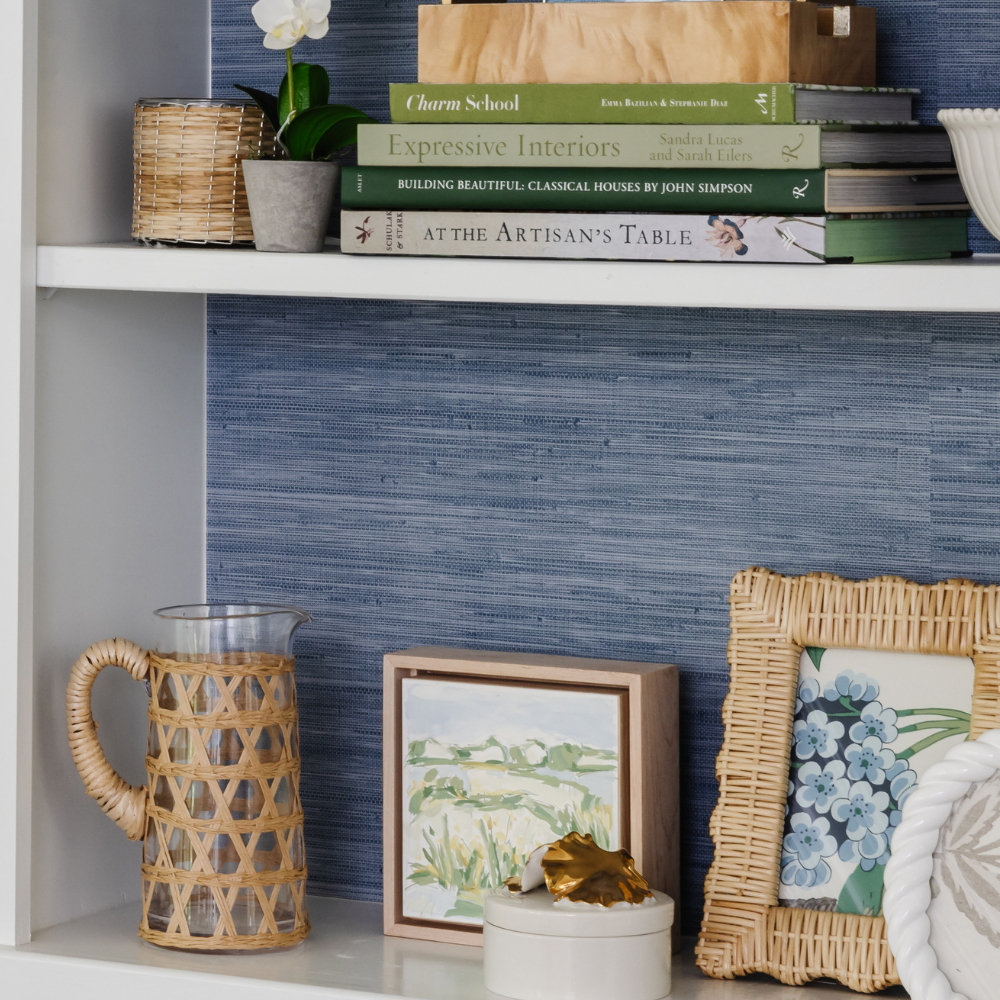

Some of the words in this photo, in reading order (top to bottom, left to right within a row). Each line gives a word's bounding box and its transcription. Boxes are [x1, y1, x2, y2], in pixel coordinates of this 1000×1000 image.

[407, 94, 461, 111] Charm
[465, 94, 519, 111] School
[660, 99, 667, 107] &
[660, 132, 703, 146] Sandra
[708, 133, 743, 146] Lucas
[388, 133, 506, 163] Expressive
[518, 134, 620, 157] Interiors
[649, 148, 673, 162] and
[677, 148, 712, 162] Sarah
[717, 148, 753, 162] Eilers
[398, 179, 454, 190] BUILDING
[457, 180, 525, 191] BEAUTIFUL:
[528, 181, 590, 192] CLASSICAL
[594, 181, 640, 193] HOUSES
[644, 182, 658, 193] BY
[661, 182, 694, 194] JOHN
[698, 182, 753, 194] SIMPSON
[385, 211, 393, 251] SCHULAK
[424, 227, 447, 241] AT
[451, 228, 487, 242] THE
[495, 222, 612, 244] ARTISAN'S
[619, 224, 692, 246] TABLE
